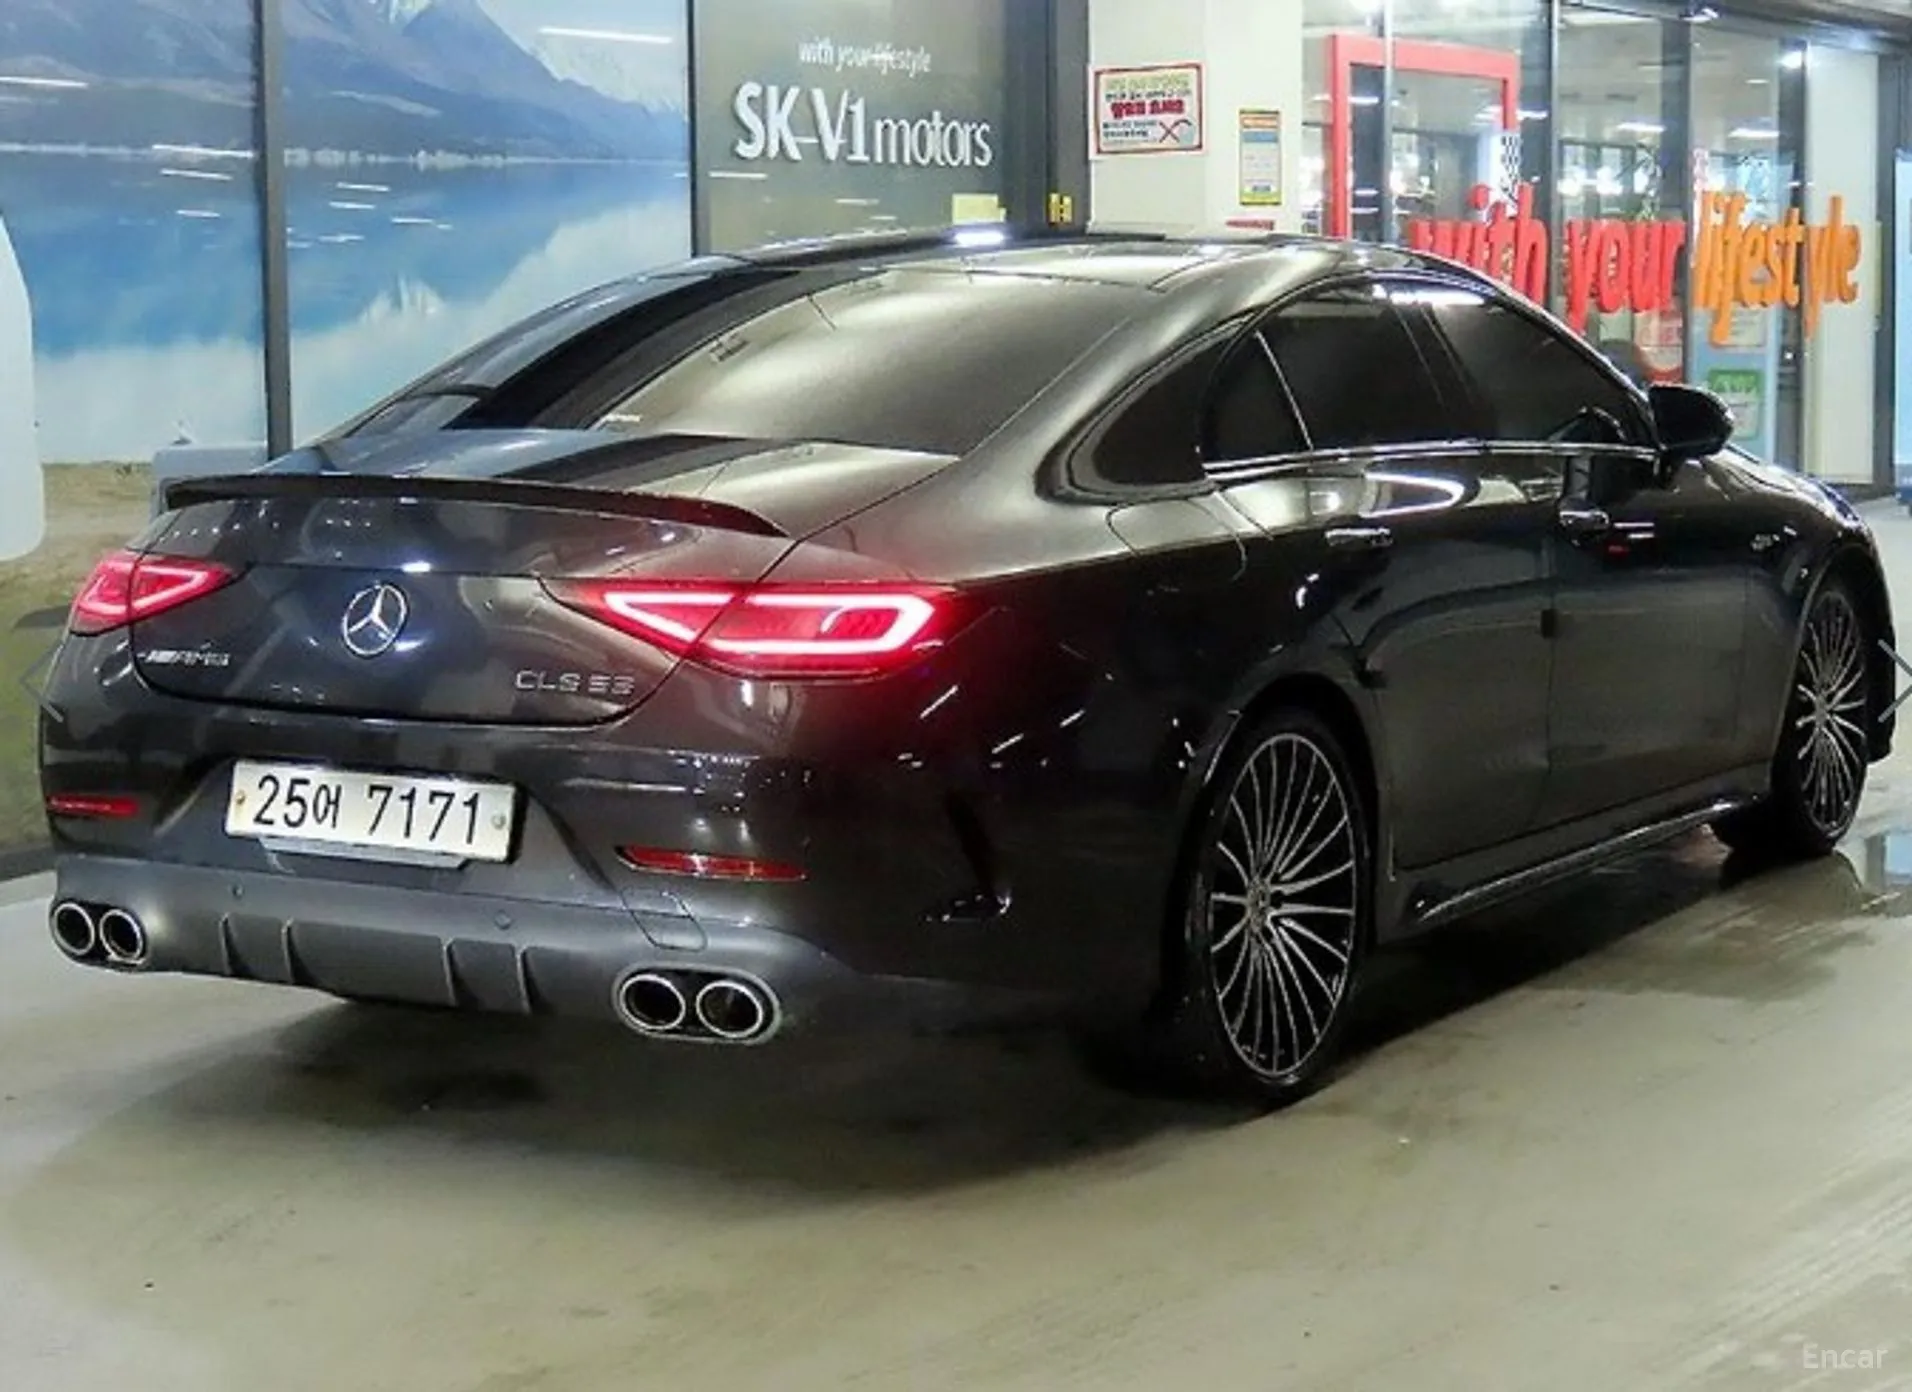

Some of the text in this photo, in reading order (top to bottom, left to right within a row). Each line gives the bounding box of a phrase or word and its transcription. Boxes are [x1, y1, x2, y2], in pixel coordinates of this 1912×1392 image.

[799, 36, 931, 78] with your lifestyle
[873, 110, 993, 166] motors
[1567, 218, 1686, 334] your
[1692, 189, 1861, 347] lifestyle
[515, 670, 635, 695] CLS 53
[253, 774, 480, 845] 25어 7171
